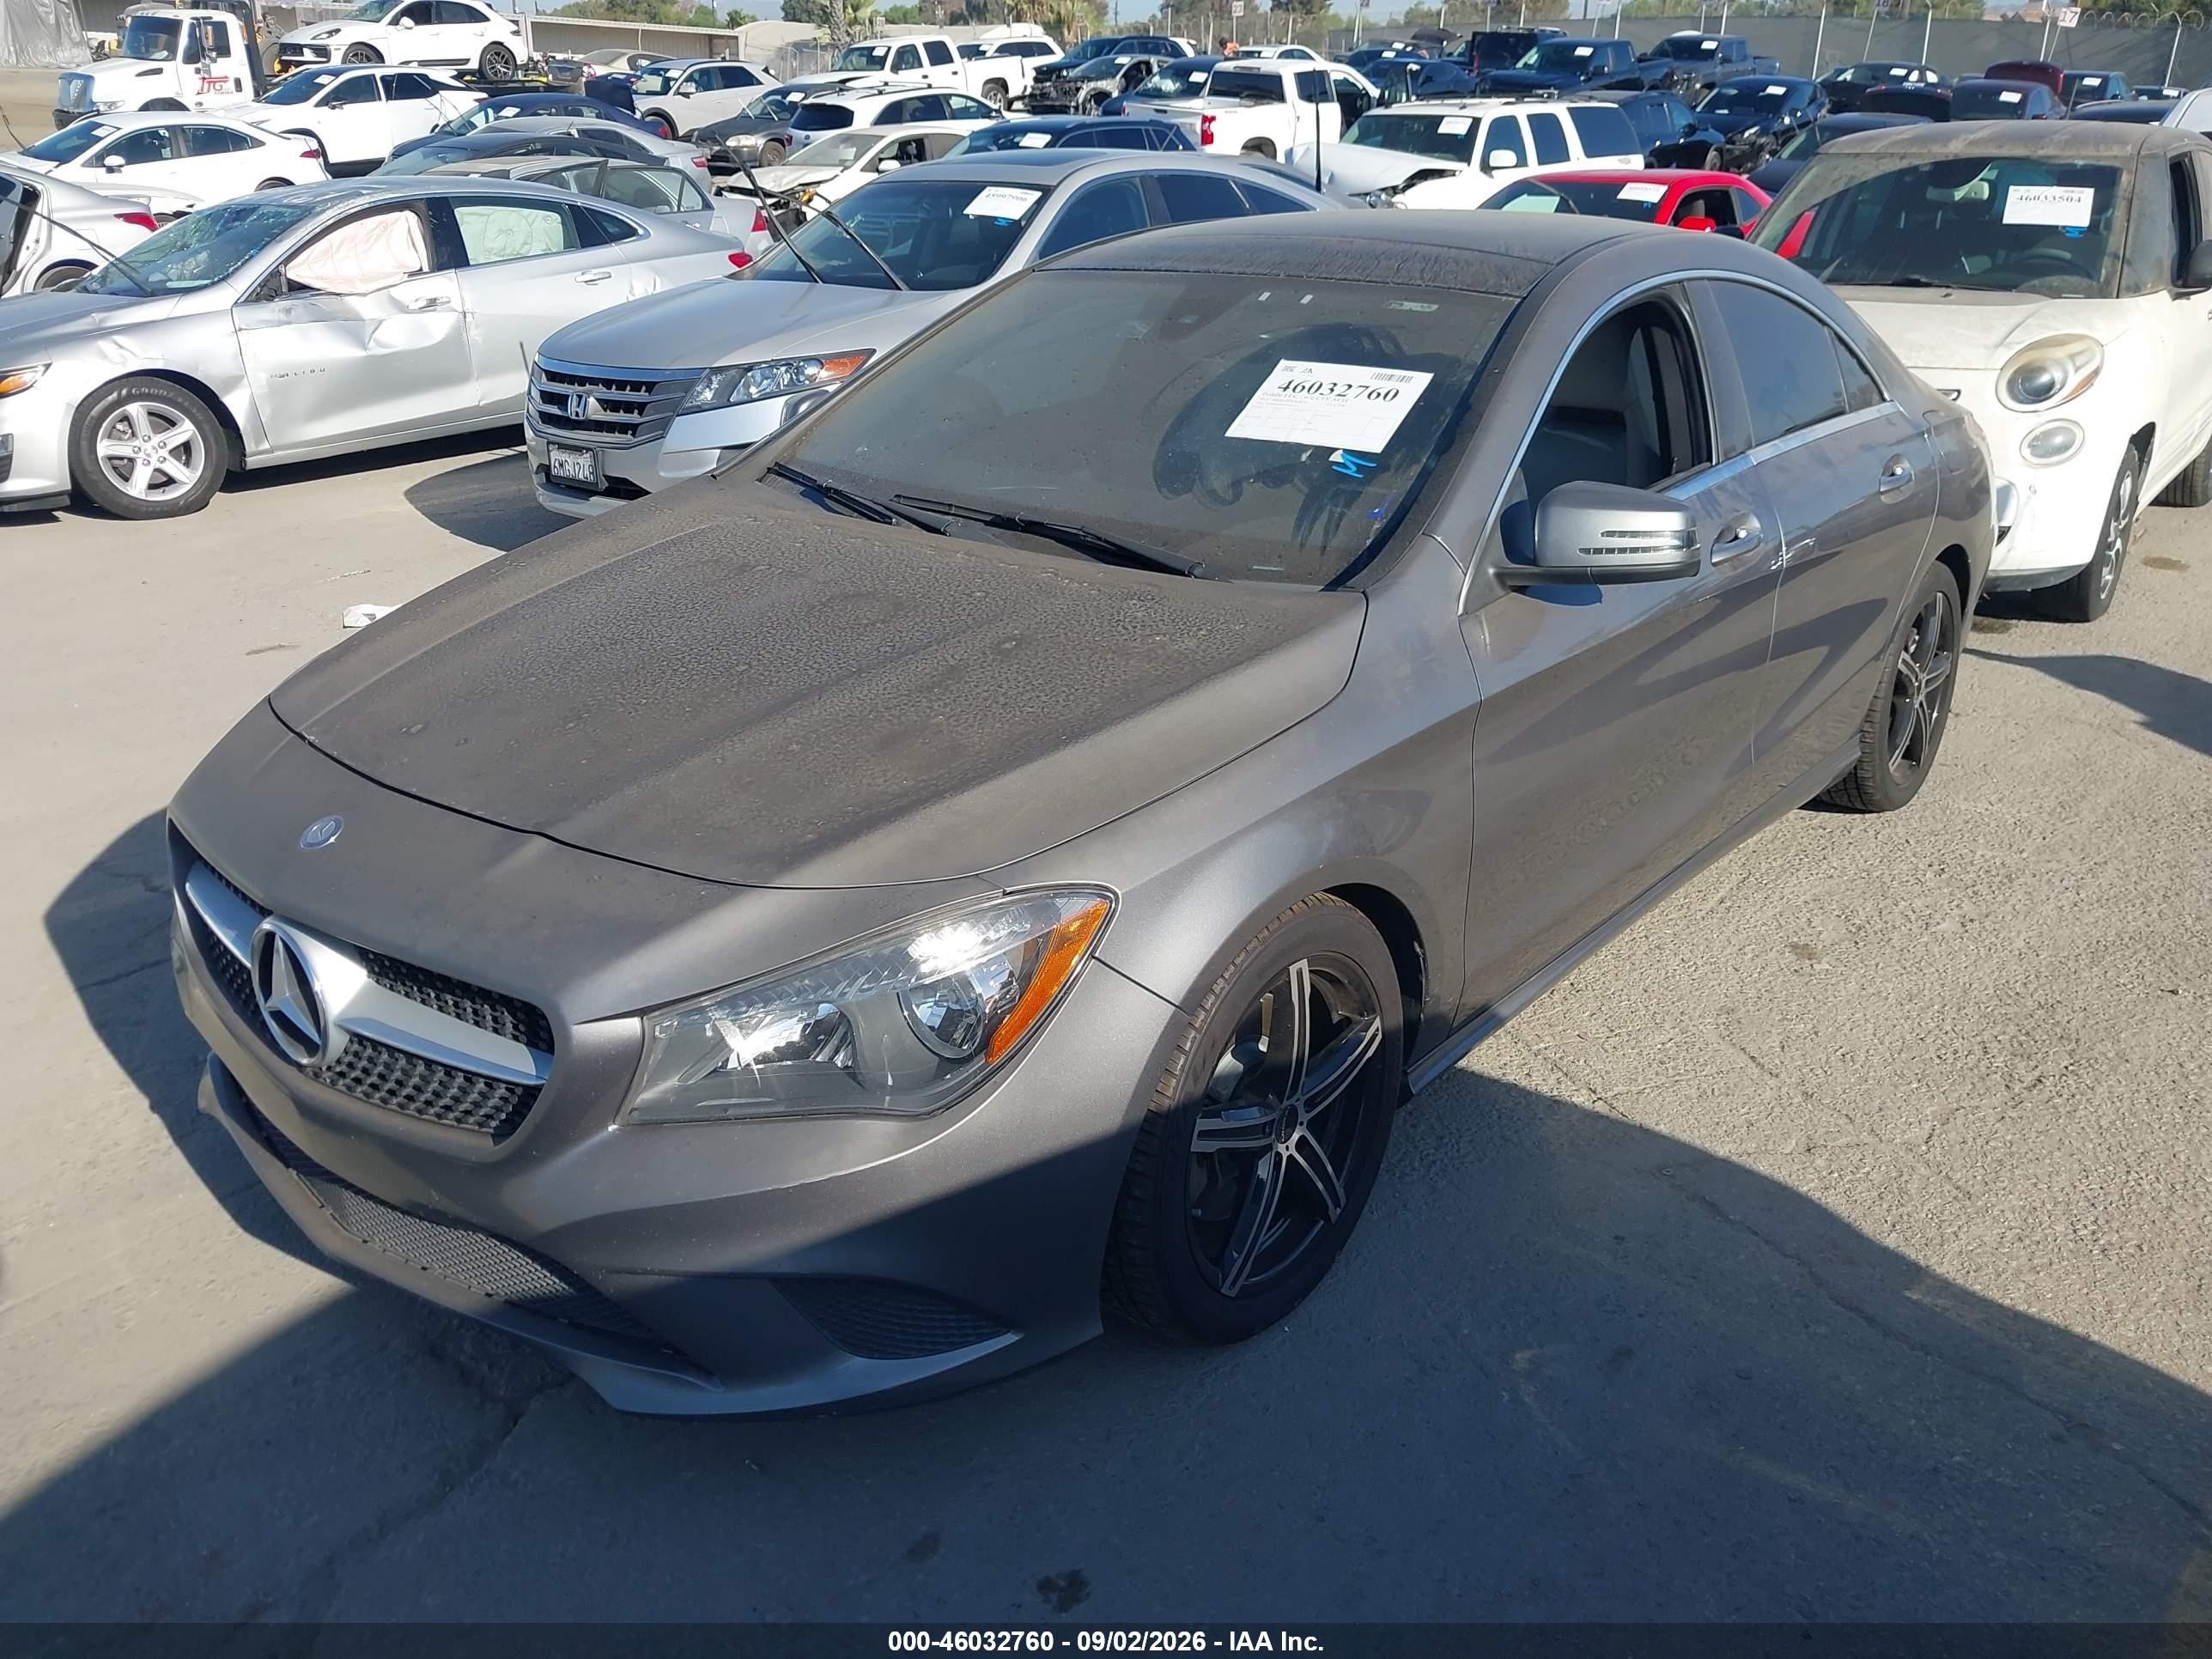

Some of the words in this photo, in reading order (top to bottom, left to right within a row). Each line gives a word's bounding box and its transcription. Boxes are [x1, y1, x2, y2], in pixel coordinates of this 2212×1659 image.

[2059, 10, 2079, 22] 17
[2015, 193, 2082, 204] 46033504
[1277, 379, 1400, 403] 46032760
